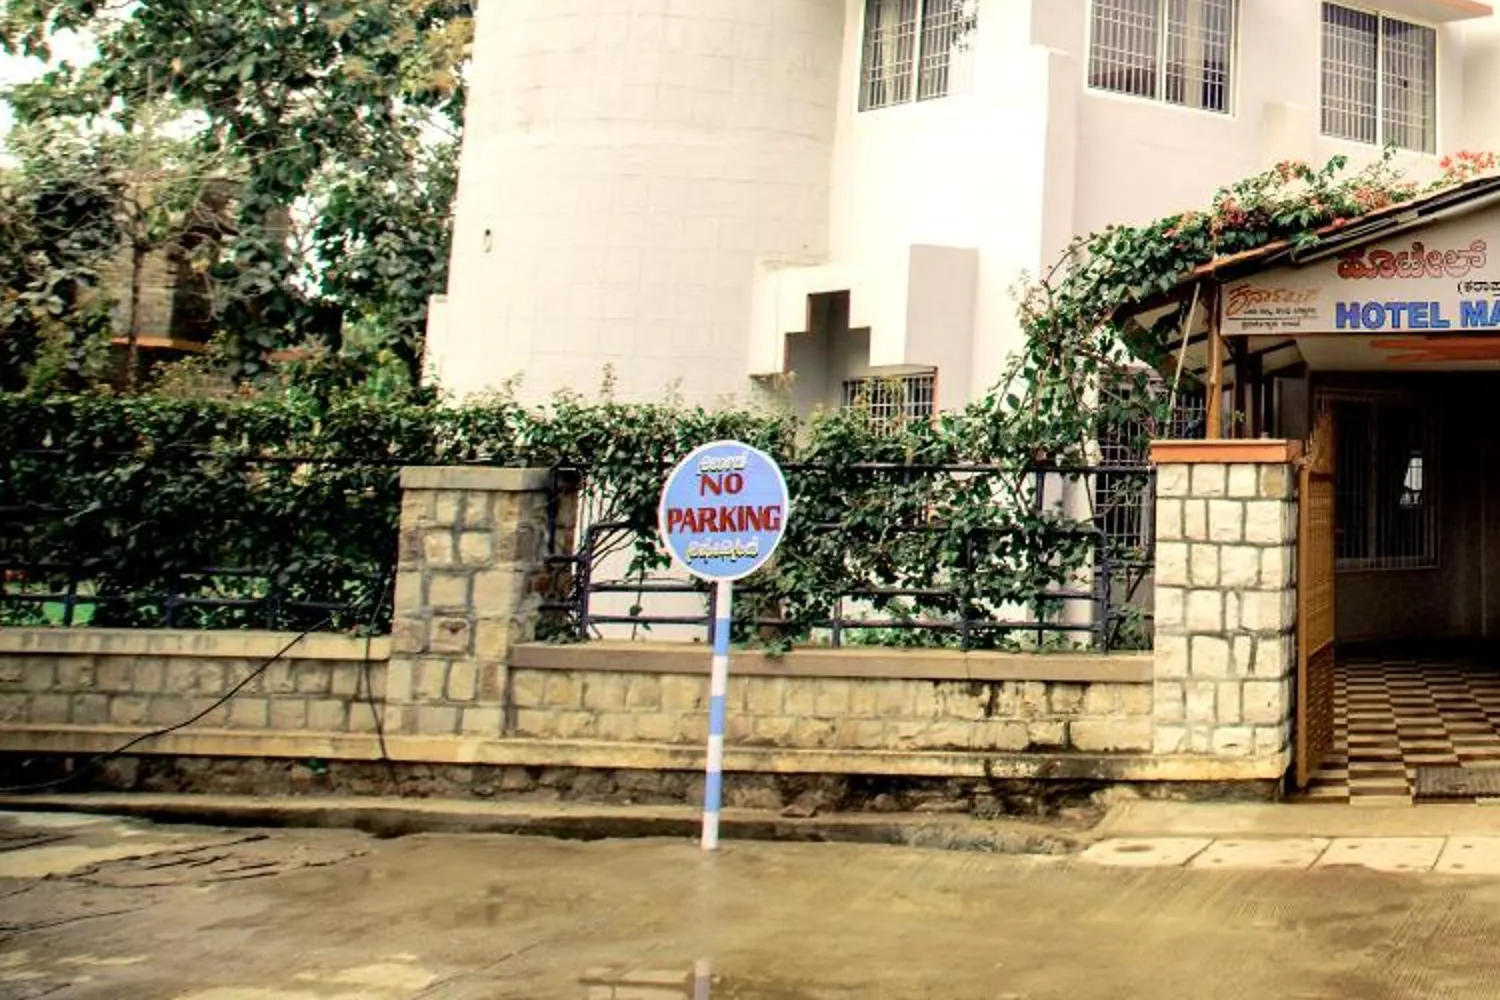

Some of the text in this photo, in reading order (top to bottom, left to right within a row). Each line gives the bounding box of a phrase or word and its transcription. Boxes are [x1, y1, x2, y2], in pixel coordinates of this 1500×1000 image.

[1335, 300, 1450, 329] HOTEL
[699, 472, 744, 497] NO
[666, 504, 782, 534] PARKING
